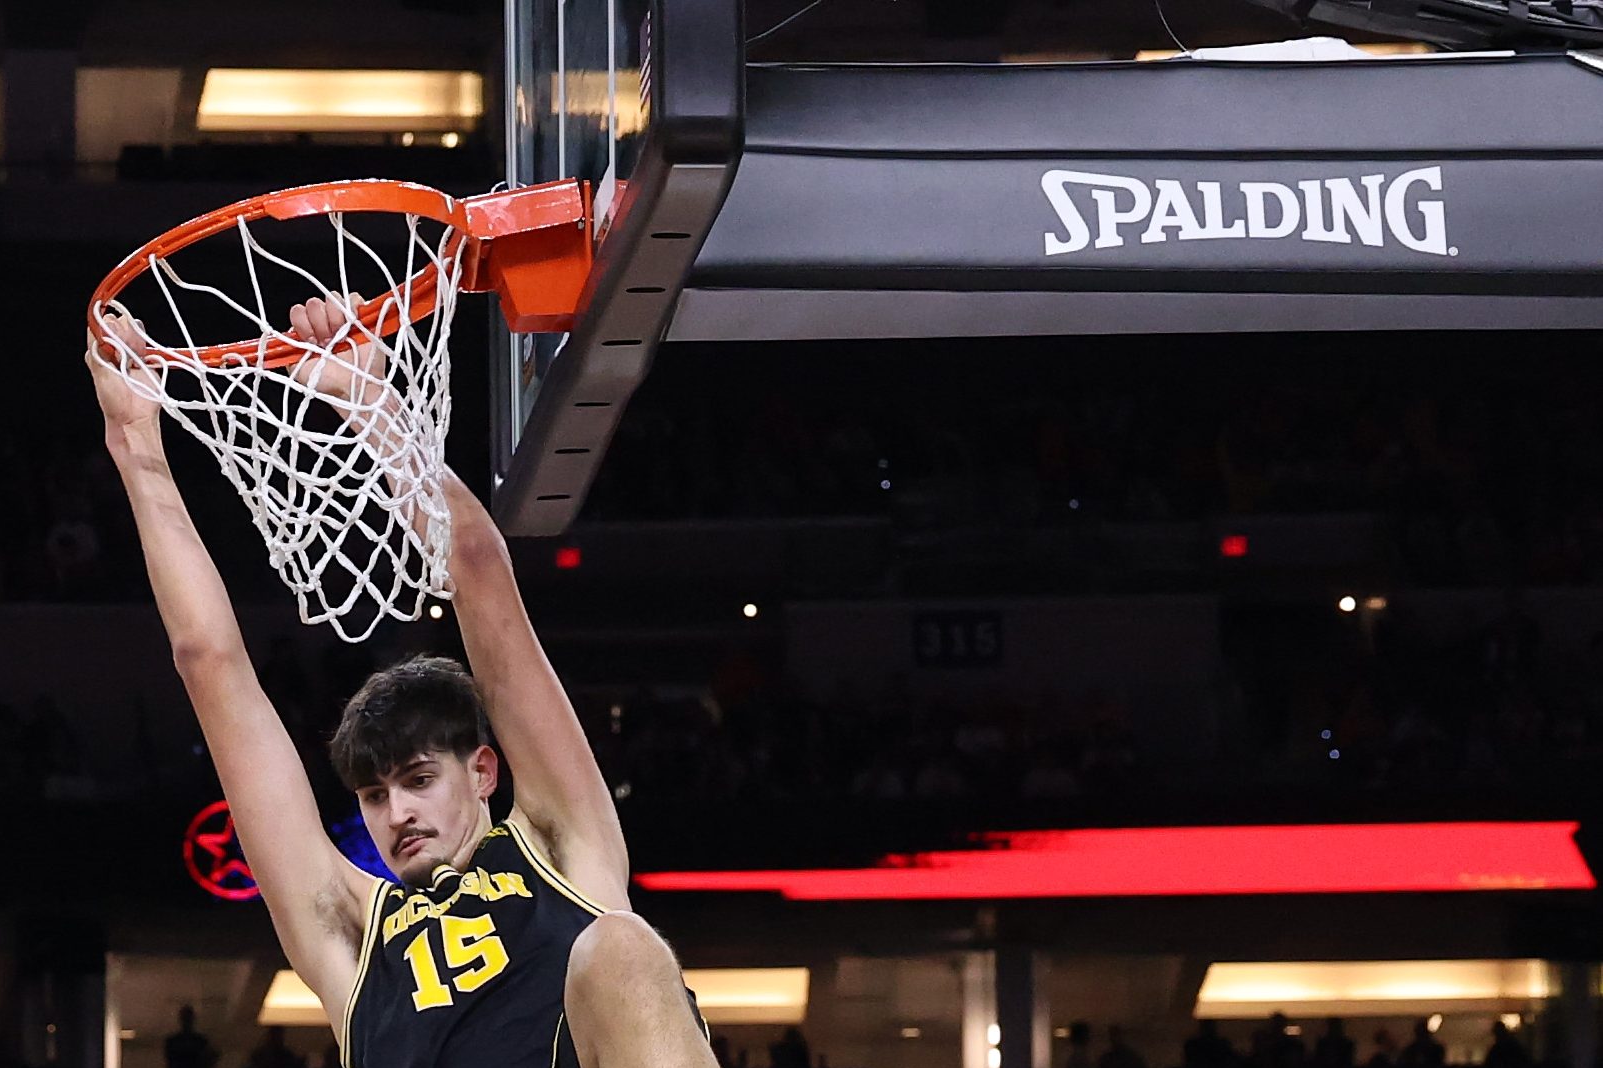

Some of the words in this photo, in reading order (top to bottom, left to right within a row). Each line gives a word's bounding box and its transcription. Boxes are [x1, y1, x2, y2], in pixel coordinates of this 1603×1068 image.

[1041, 166, 1448, 257] SPALDING
[920, 621, 997, 658] 315
[403, 913, 511, 1012] 15
